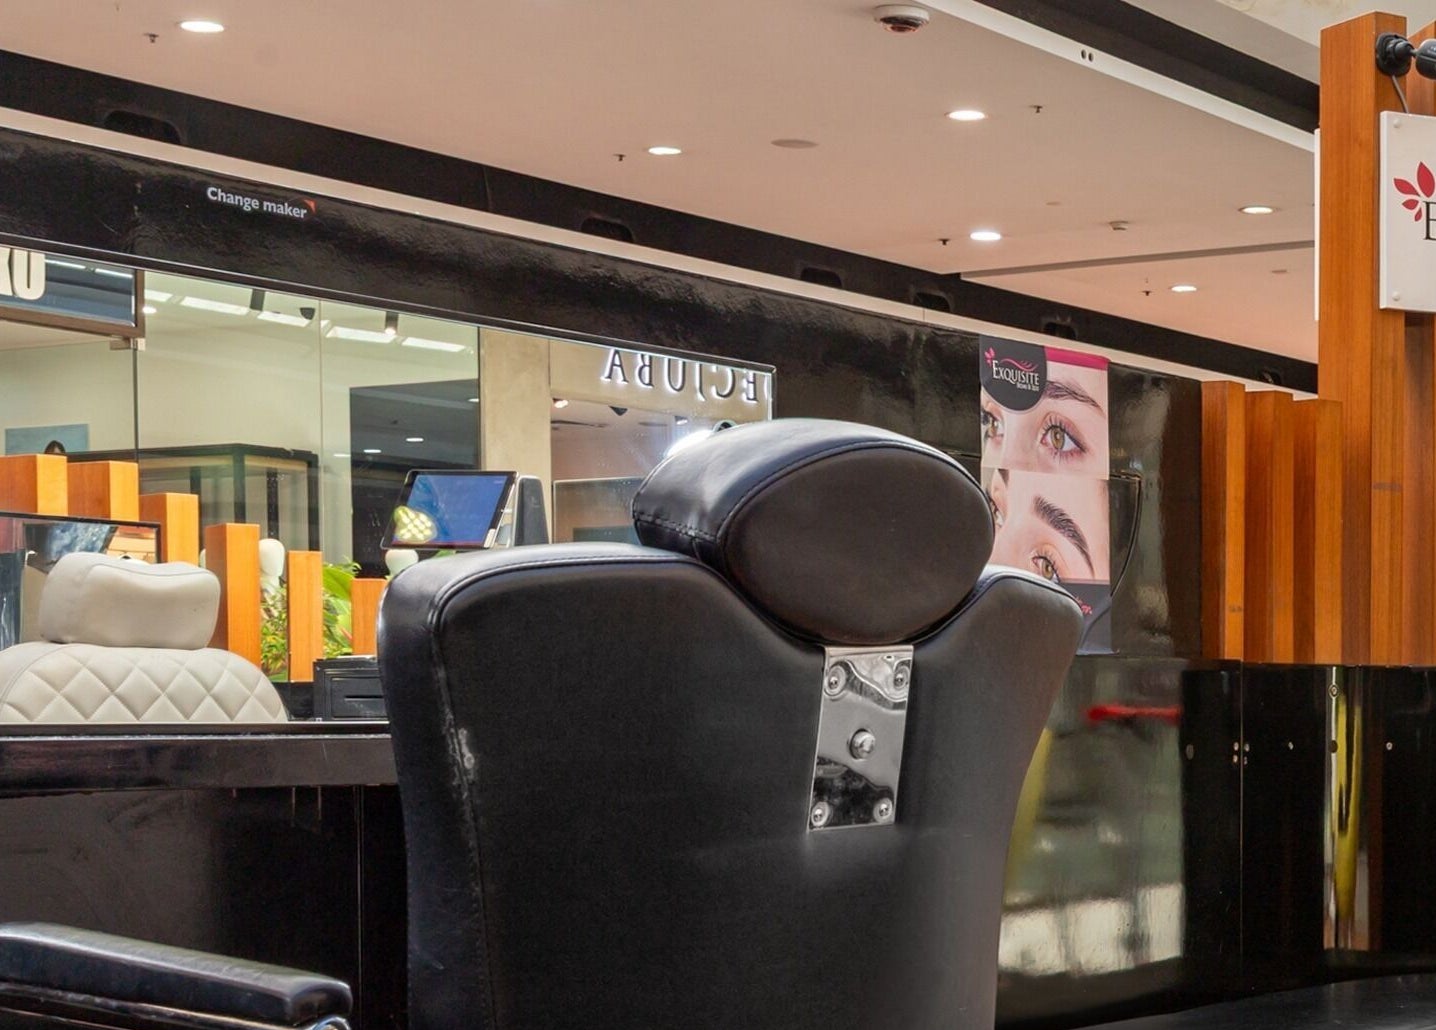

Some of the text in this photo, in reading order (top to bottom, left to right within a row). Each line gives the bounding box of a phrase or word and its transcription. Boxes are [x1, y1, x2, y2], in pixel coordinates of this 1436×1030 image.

[206, 186, 308, 218] Change maker
[992, 360, 1040, 385] EXQUISITE
